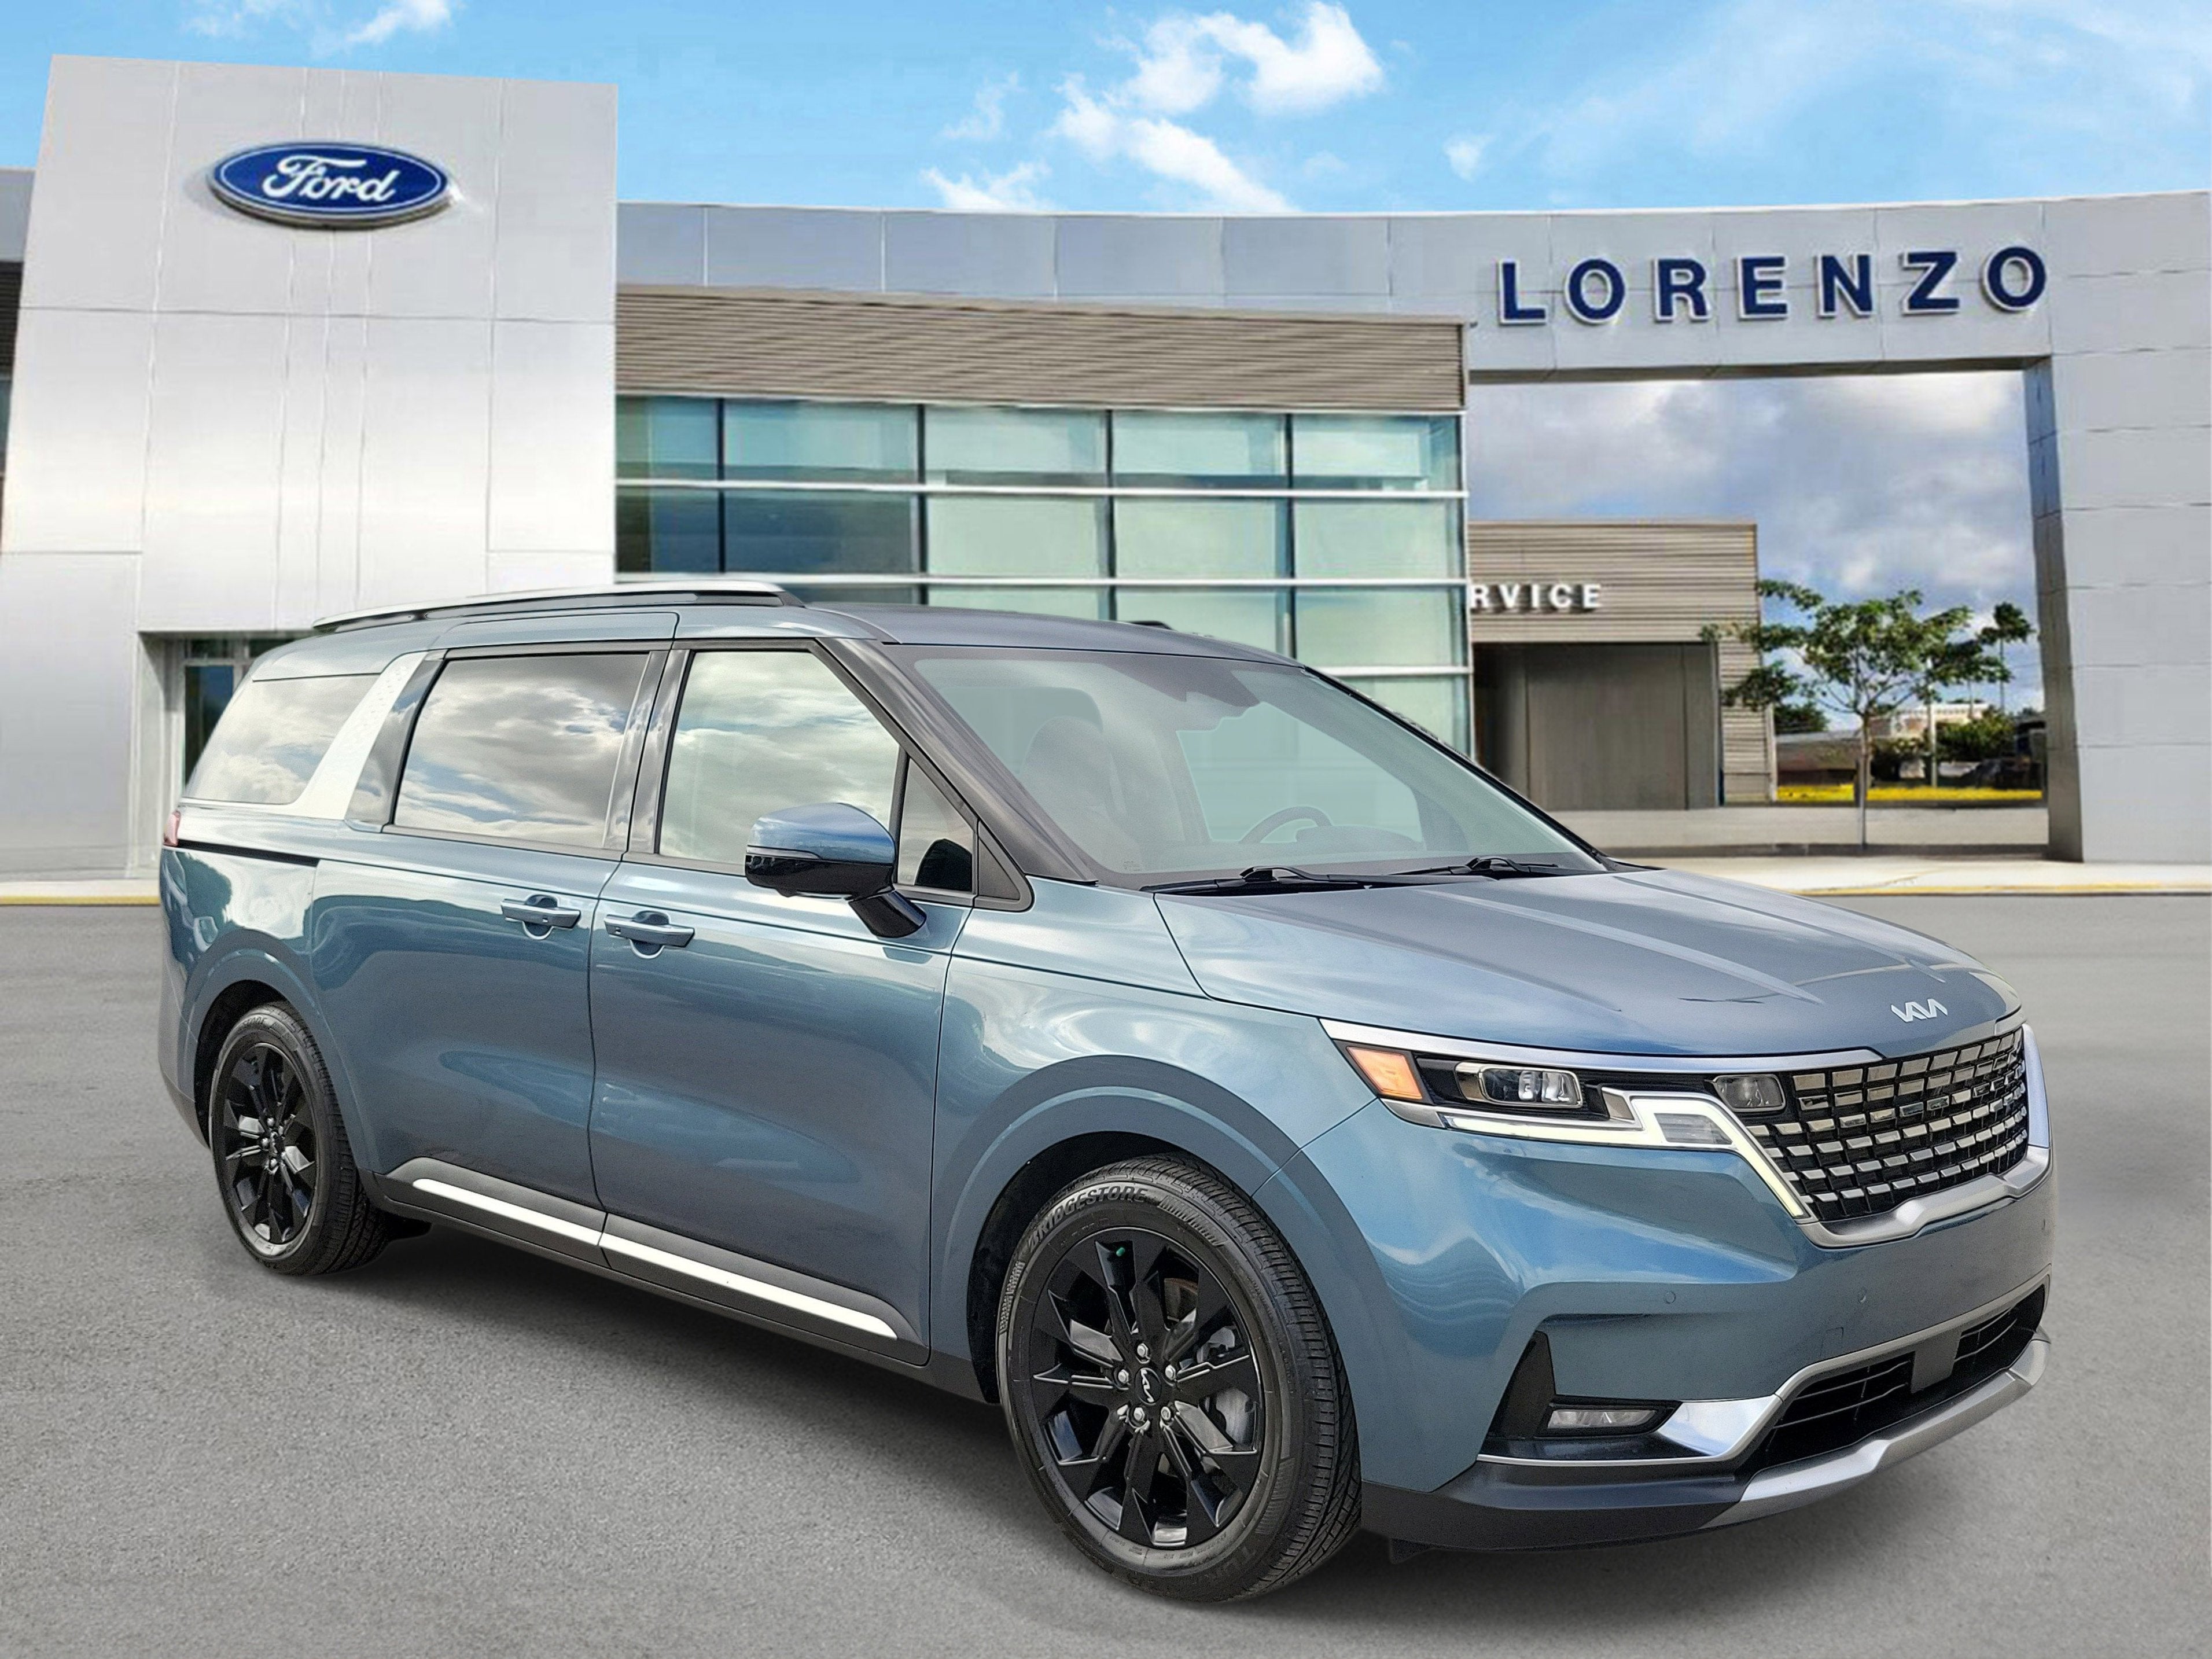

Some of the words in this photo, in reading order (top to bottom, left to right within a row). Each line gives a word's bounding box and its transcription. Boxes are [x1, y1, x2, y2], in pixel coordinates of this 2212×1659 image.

[262, 154, 400, 202] Ford
[1497, 246, 2048, 325] LORENZO
[1027, 1186, 1149, 1253] BRIDGESTONE
